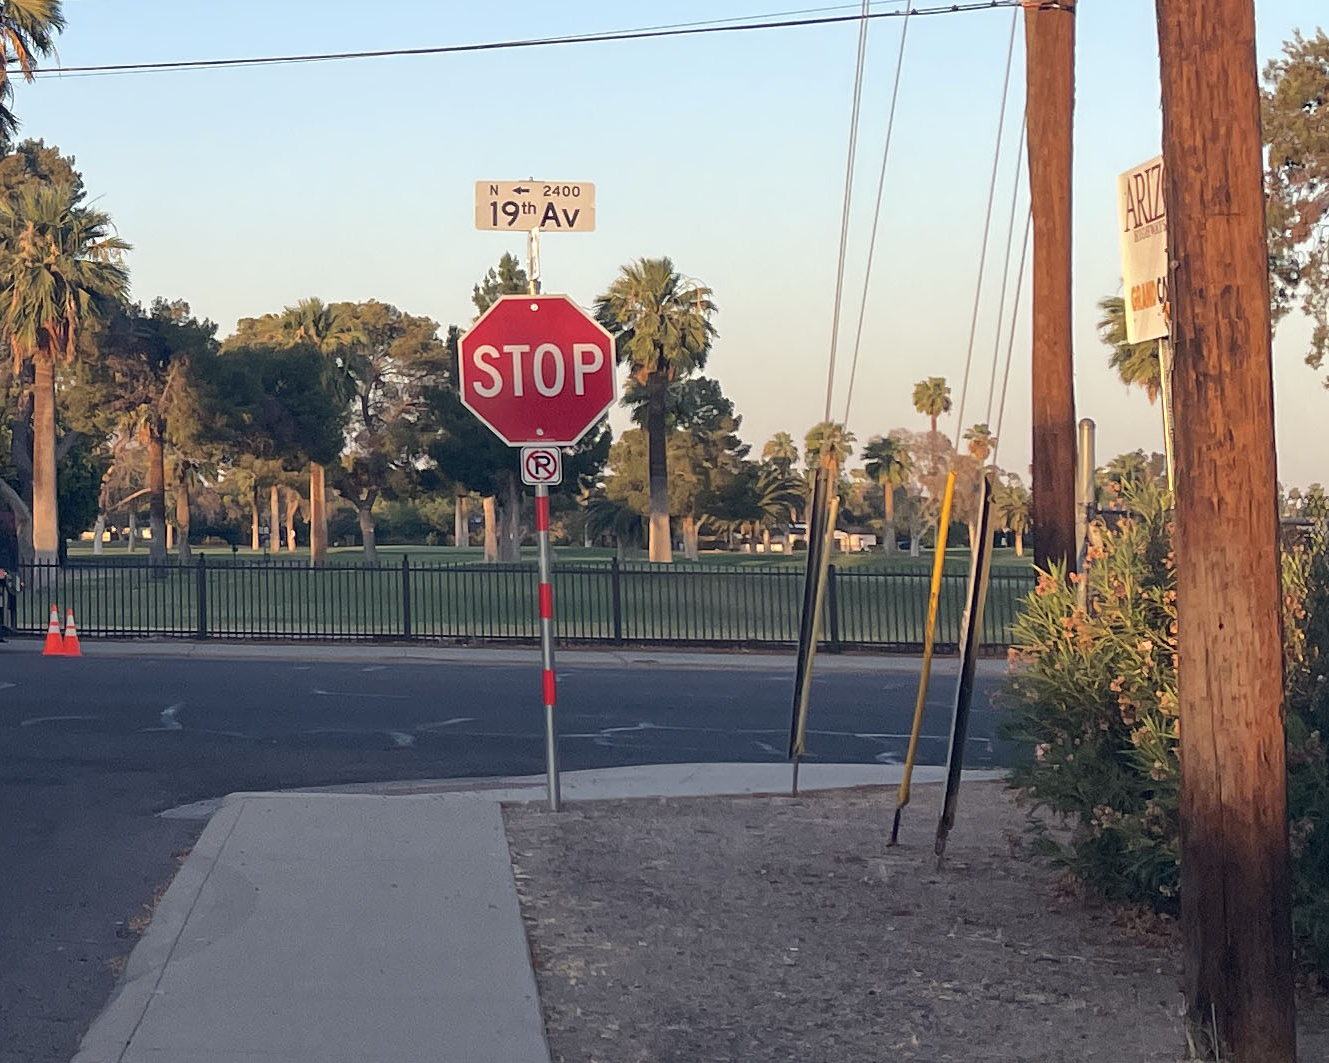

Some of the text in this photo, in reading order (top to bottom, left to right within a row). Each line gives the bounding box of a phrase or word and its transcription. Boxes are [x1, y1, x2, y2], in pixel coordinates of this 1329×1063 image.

[490, 184, 581, 197] N 2400
[1124, 161, 1166, 233] ARIZ
[490, 201, 580, 228] 19th Av
[472, 343, 604, 398] STOP
